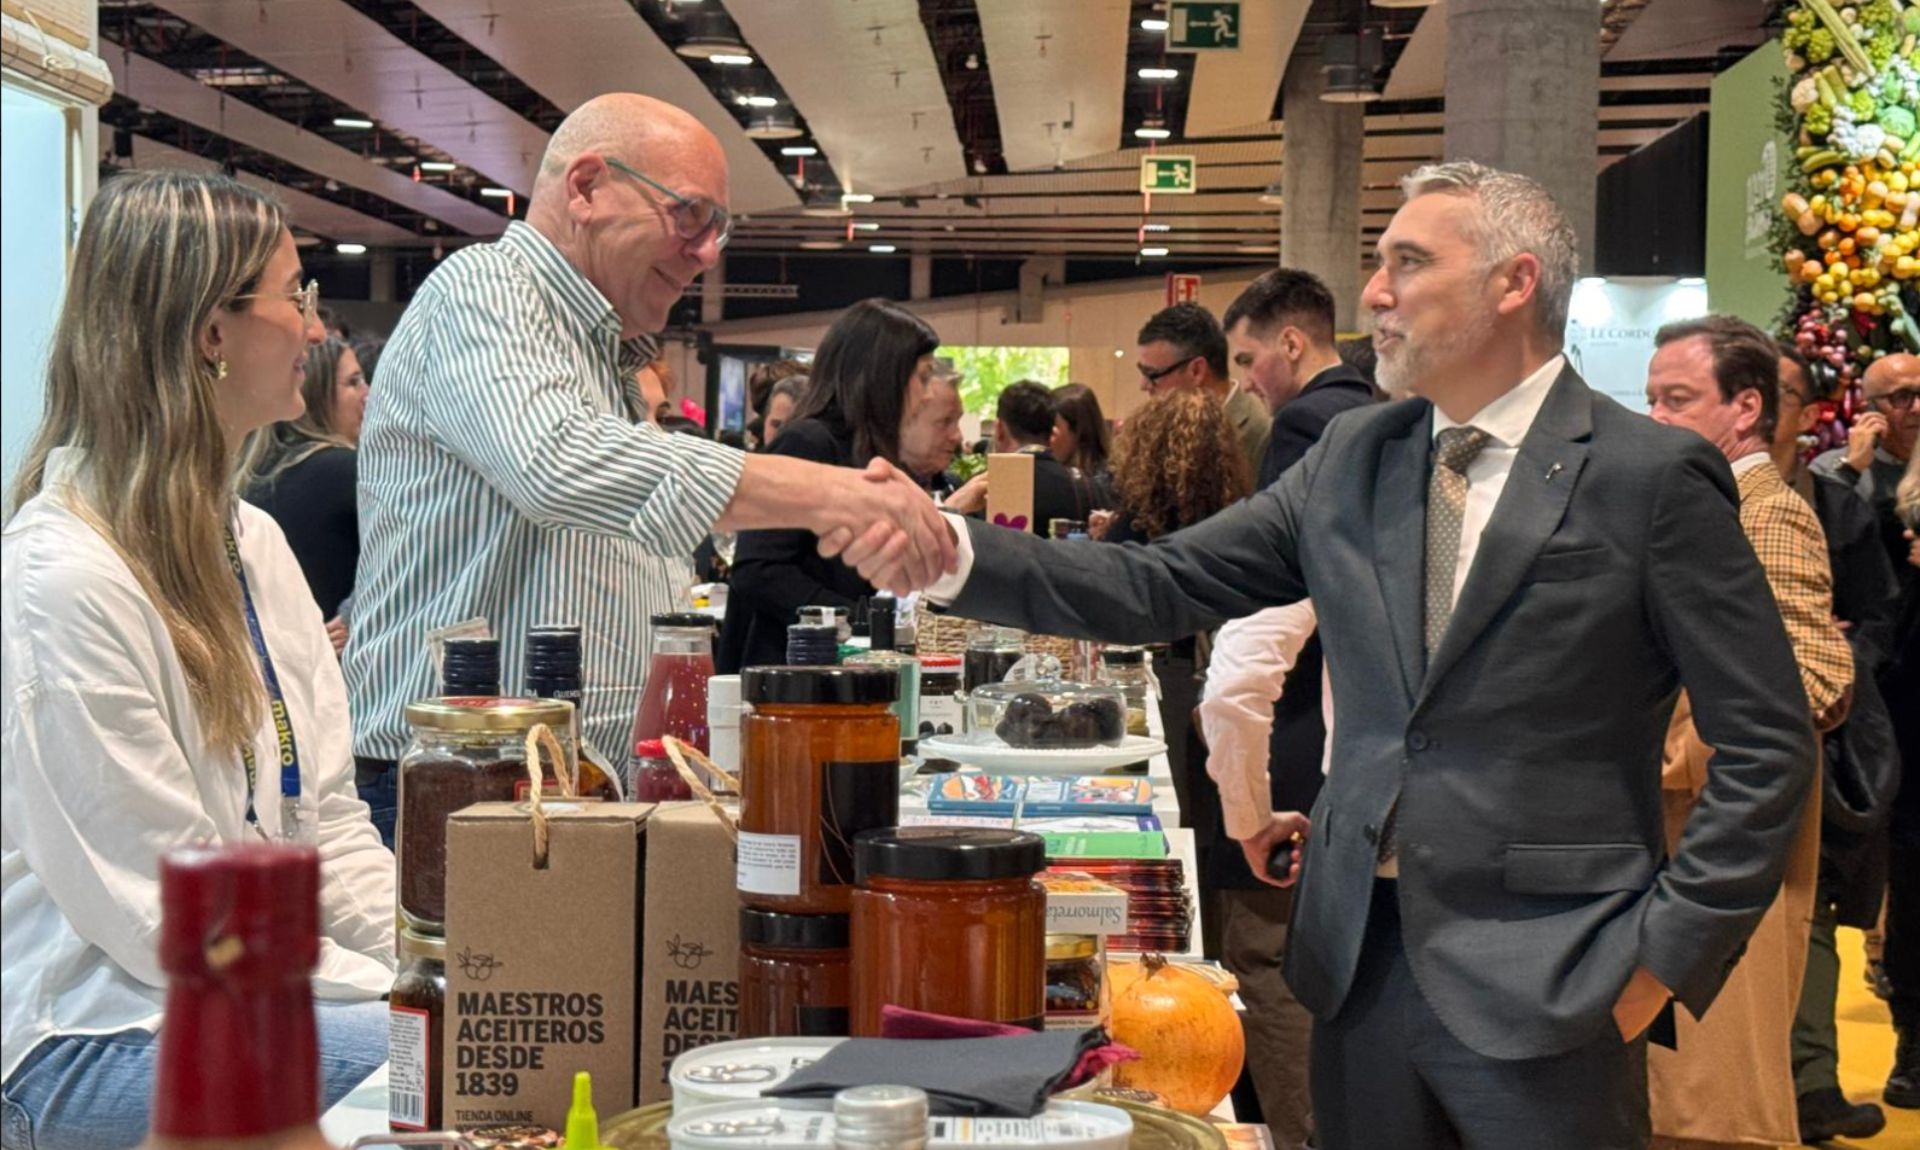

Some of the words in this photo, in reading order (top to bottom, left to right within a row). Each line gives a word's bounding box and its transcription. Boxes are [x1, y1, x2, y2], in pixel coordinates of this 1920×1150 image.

[272, 700, 294, 767] makro
[457, 992, 604, 1017] MAESTROS
[456, 1018, 605, 1044] ACEITEROS
[456, 1045, 544, 1070] DESDE
[455, 1072, 519, 1096] 1839
[455, 1109, 493, 1122] TIENDA
[495, 1110, 533, 1122] ONLINE
